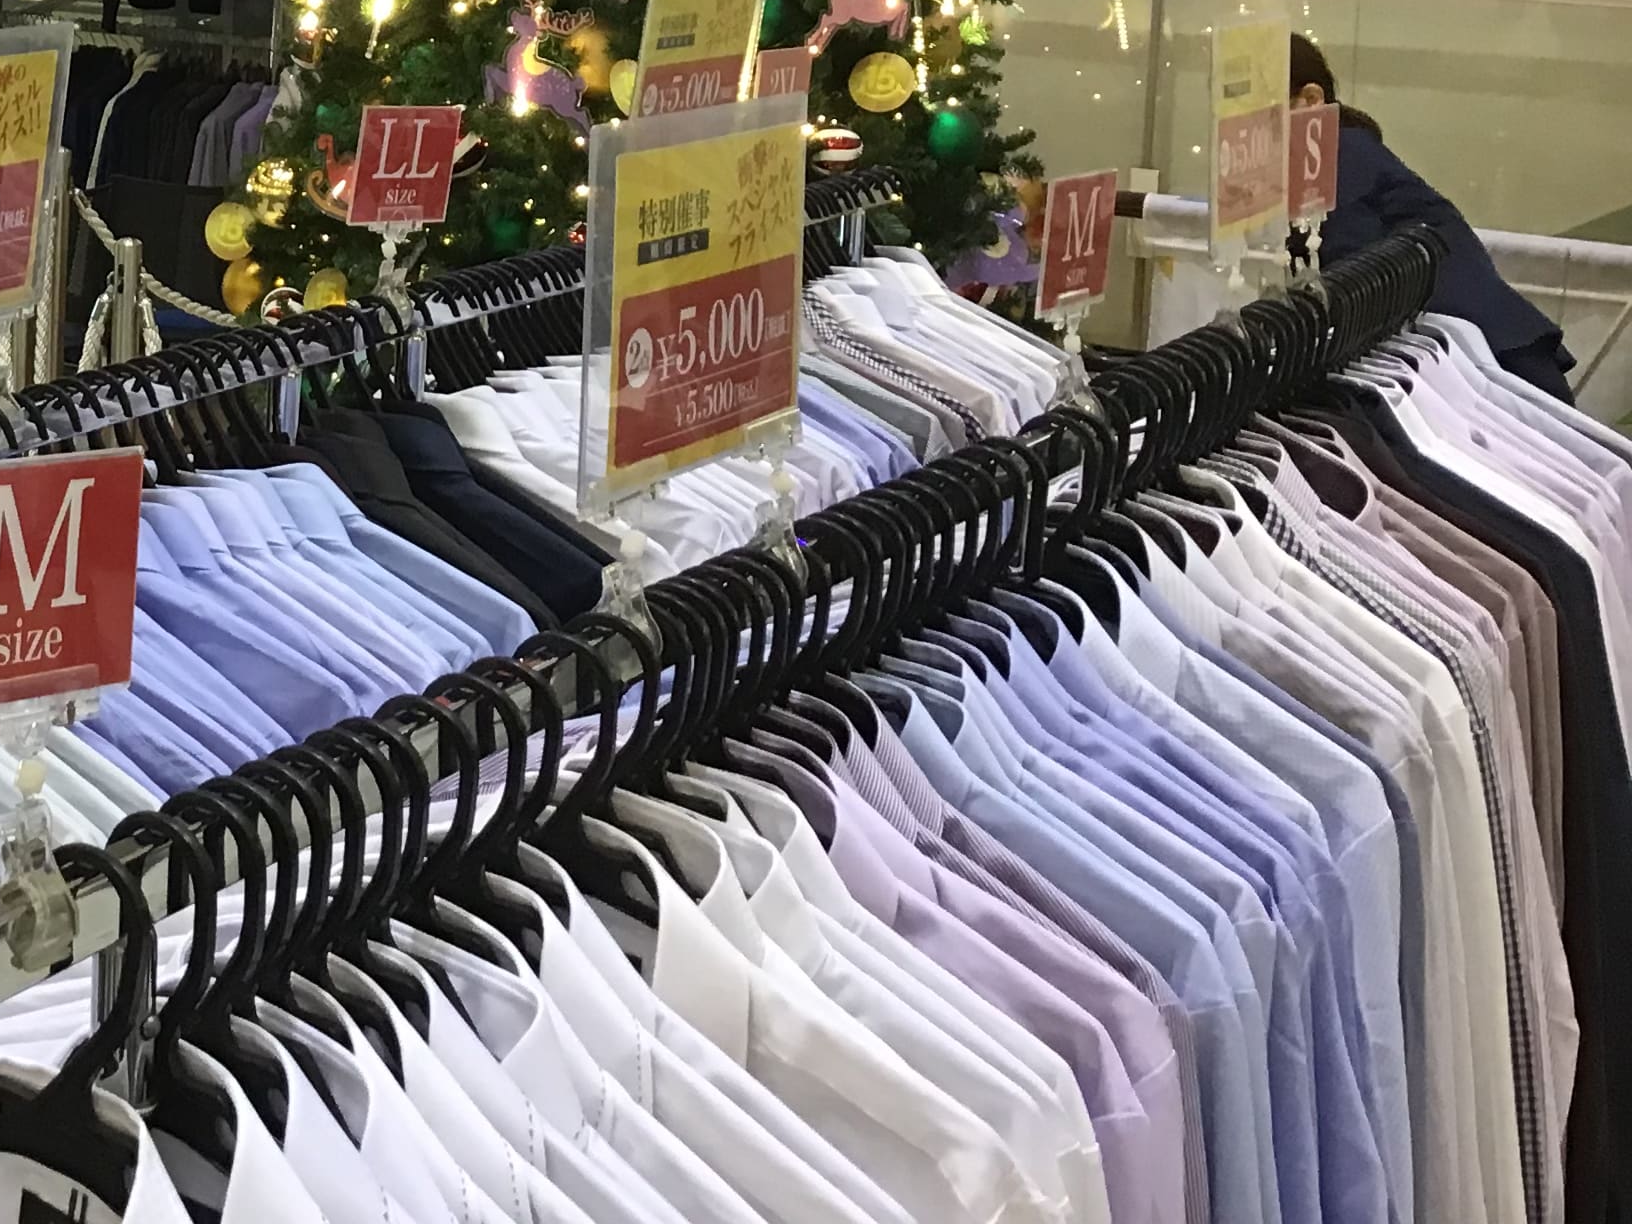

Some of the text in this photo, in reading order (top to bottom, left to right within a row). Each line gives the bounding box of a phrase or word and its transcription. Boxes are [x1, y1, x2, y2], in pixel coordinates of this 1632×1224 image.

[372, 118, 439, 179] LL
[1304, 117, 1322, 181] S
[384, 183, 417, 204] size
[638, 188, 710, 240] 特別催事
[1061, 186, 1102, 263] M
[656, 287, 765, 383] ¥5,000
[675, 378, 734, 428] ¥5,500
